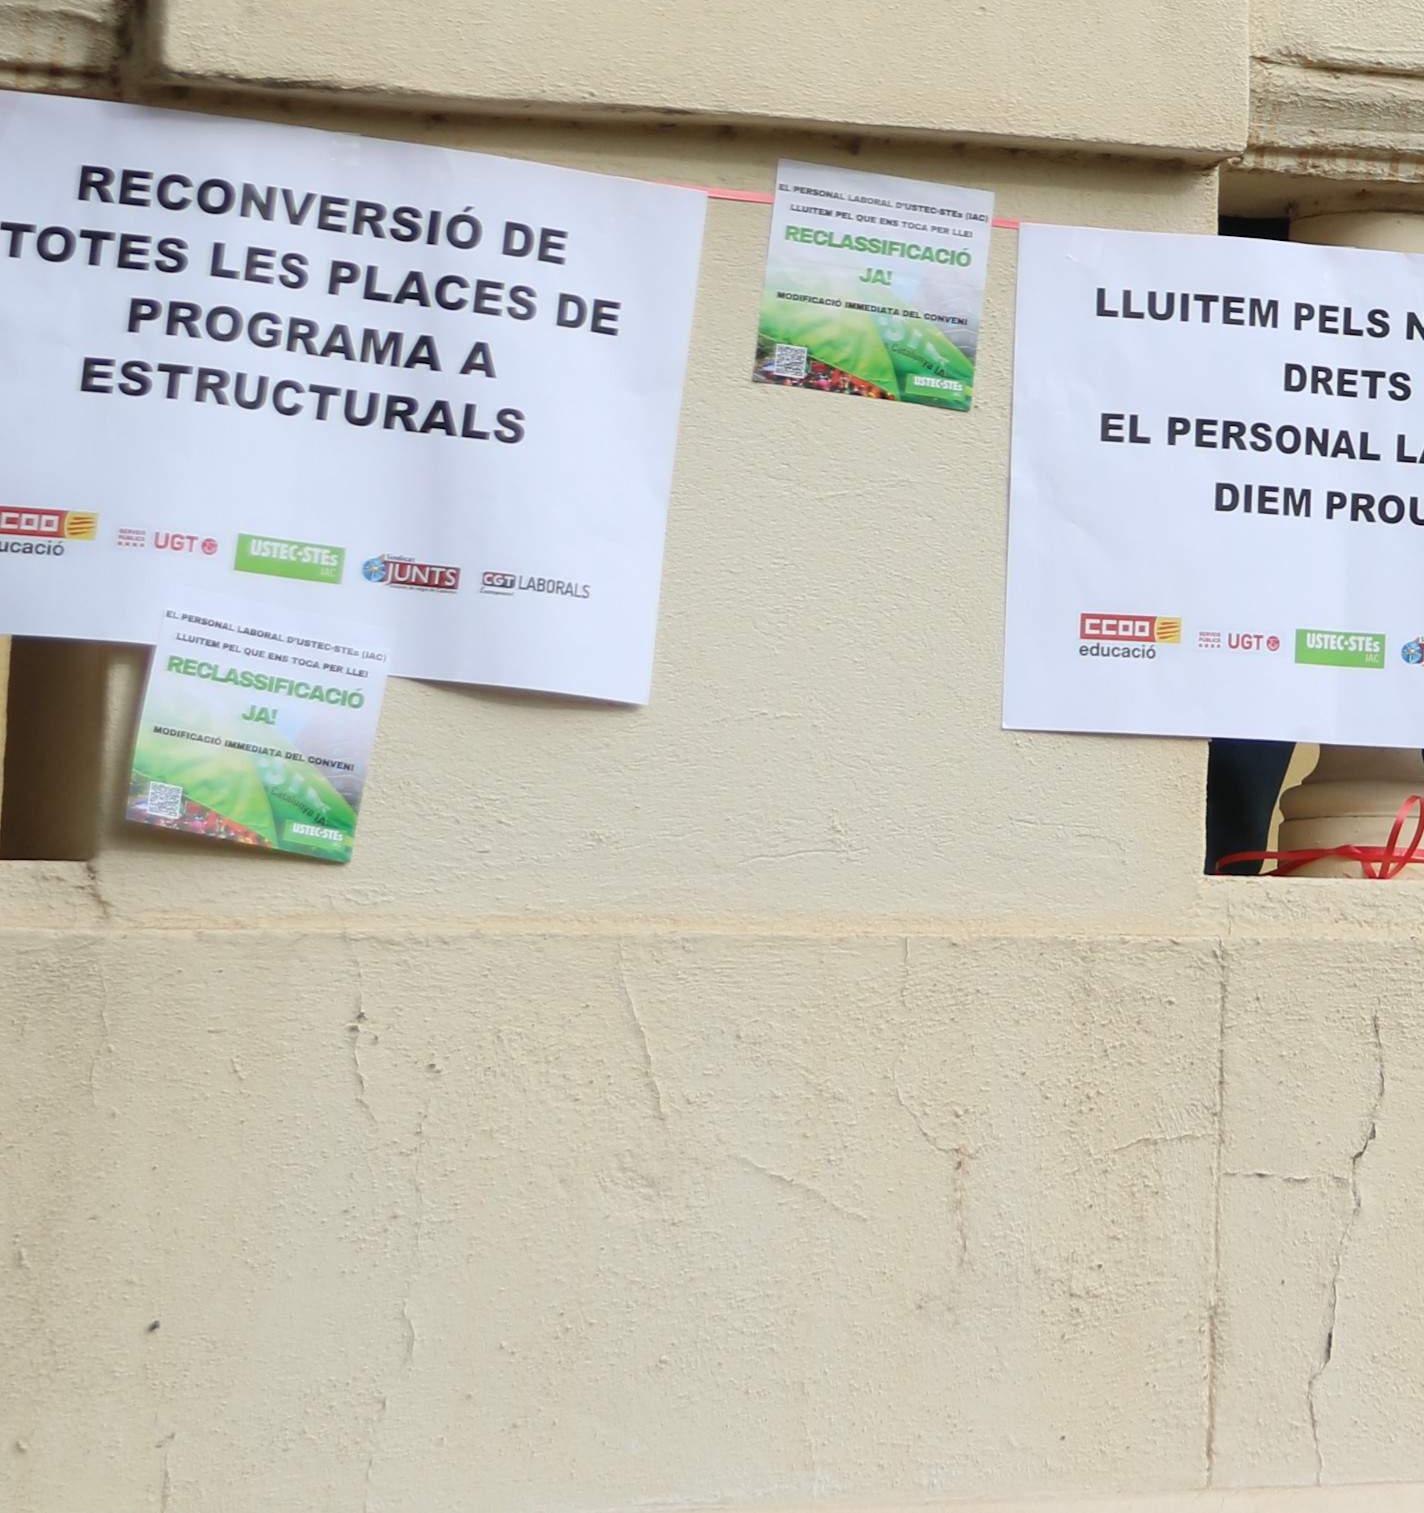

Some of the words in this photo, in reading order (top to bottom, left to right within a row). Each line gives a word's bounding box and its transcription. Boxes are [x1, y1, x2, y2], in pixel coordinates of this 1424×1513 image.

[77, 164, 482, 249] RECONVERSIÓ
[502, 222, 569, 265] DE
[785, 225, 971, 268] RECLASSIFICACIÓ
[0, 220, 188, 274] TOTES
[210, 242, 309, 289] LES
[327, 262, 537, 320] PLACES
[556, 292, 621, 337] DE
[859, 268, 892, 286] JA!
[777, 291, 841, 307] MODIFICACIÓ
[845, 301, 899, 316] IMMEDIATA
[903, 309, 921, 319] DEL
[924, 312, 968, 326] CONVENI
[1095, 288, 1279, 329] LLUITEM
[1293, 302, 1390, 339] PELS
[127, 299, 442, 372] PROGRAMA
[461, 342, 497, 378] A
[1284, 363, 1412, 401] DRETS
[79, 358, 526, 445] ESTRUCTURALS
[1100, 413, 1150, 445] EL
[1167, 417, 1380, 462] PERSONAL
[1215, 483, 1311, 518] DIEM
[154, 532, 198, 552] UGT
[386, 562, 456, 586] JUNTS
[483, 573, 515, 586] CGT
[518, 576, 590, 598] LABORALS
[1085, 619, 1149, 636] CCOO
[1228, 633, 1263, 651] UGT
[1079, 644, 1156, 659] educació
[167, 655, 364, 708] RECLASSIFICACIÓ
[241, 705, 278, 725] JA!
[153, 726, 222, 745] MODIFICACIÓ
[225, 740, 282, 757] IMMEDIATA
[285, 751, 305, 762] DEL
[308, 756, 354, 771] CONVENI
